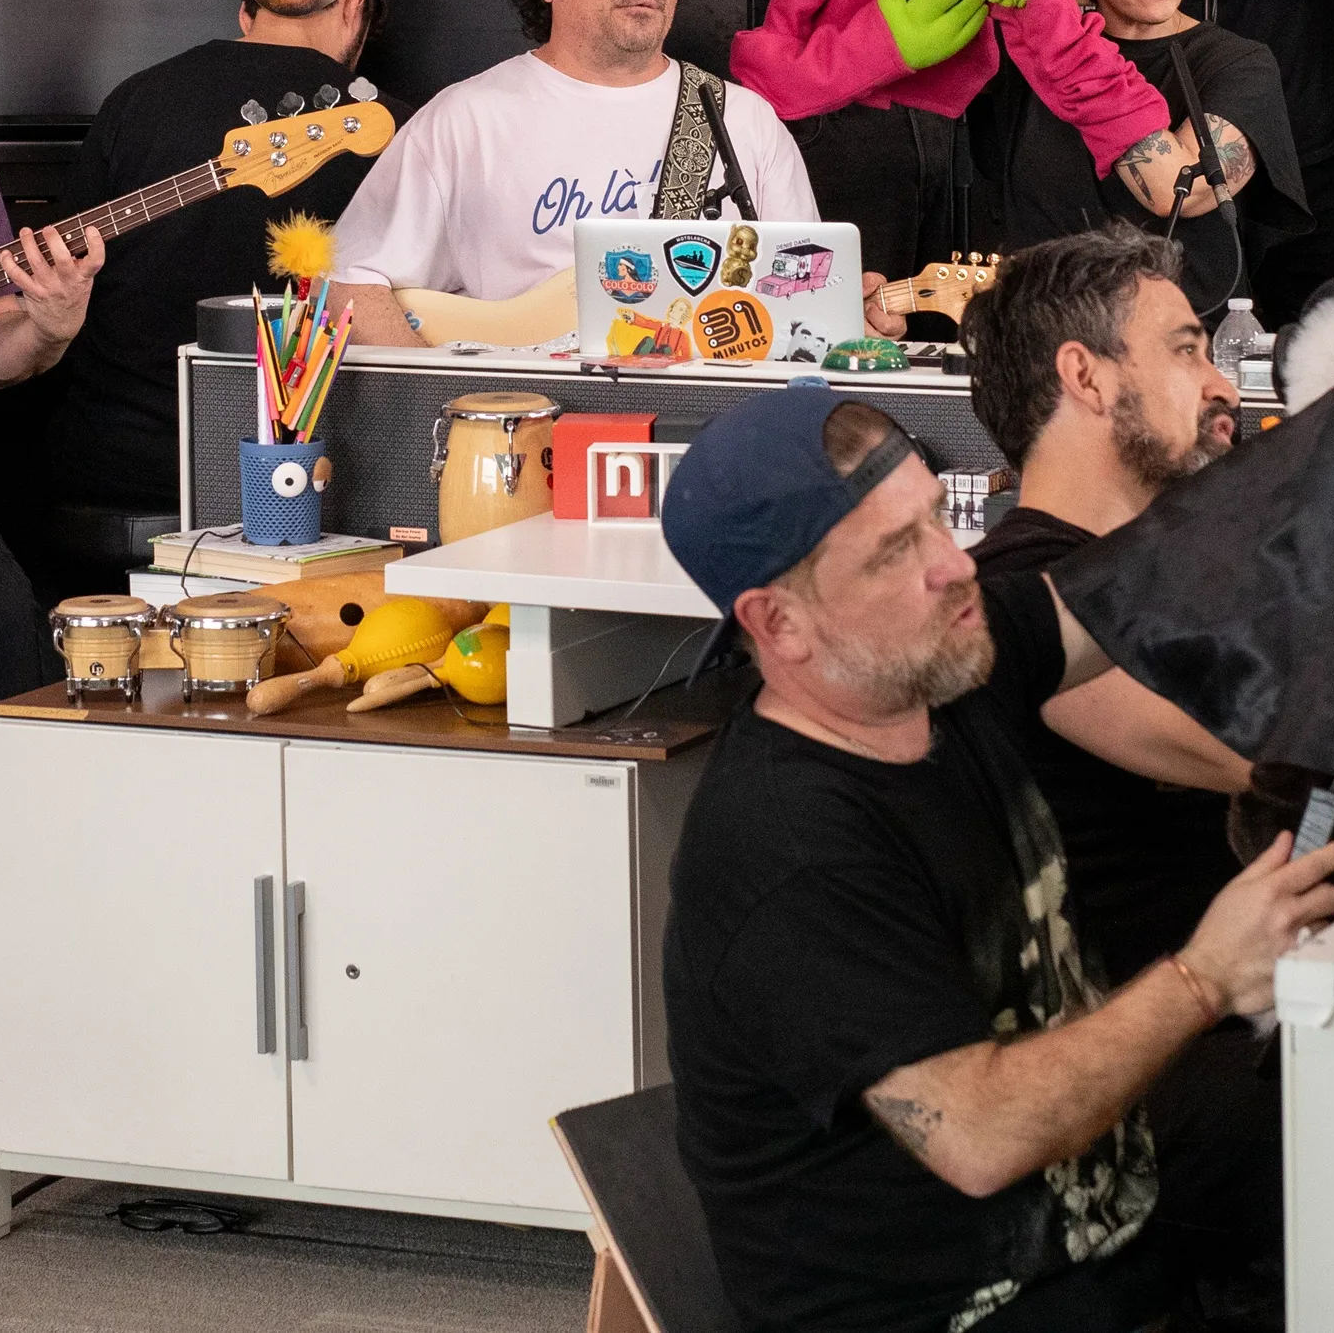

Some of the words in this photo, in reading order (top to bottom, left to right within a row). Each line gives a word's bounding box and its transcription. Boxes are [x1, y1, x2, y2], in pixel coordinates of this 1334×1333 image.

[532, 177, 593, 235] Oh
[601, 168, 642, 215] là
[676, 236, 711, 244] MOTOLANCHA
[776, 239, 793, 250] DENIS
[793, 237, 811, 247] DANIS
[605, 280, 628, 291] COLO
[630, 281, 655, 292] COLO
[699, 300, 763, 349] 31
[712, 335, 769, 359] MINUTOS
[606, 453, 644, 497] n
